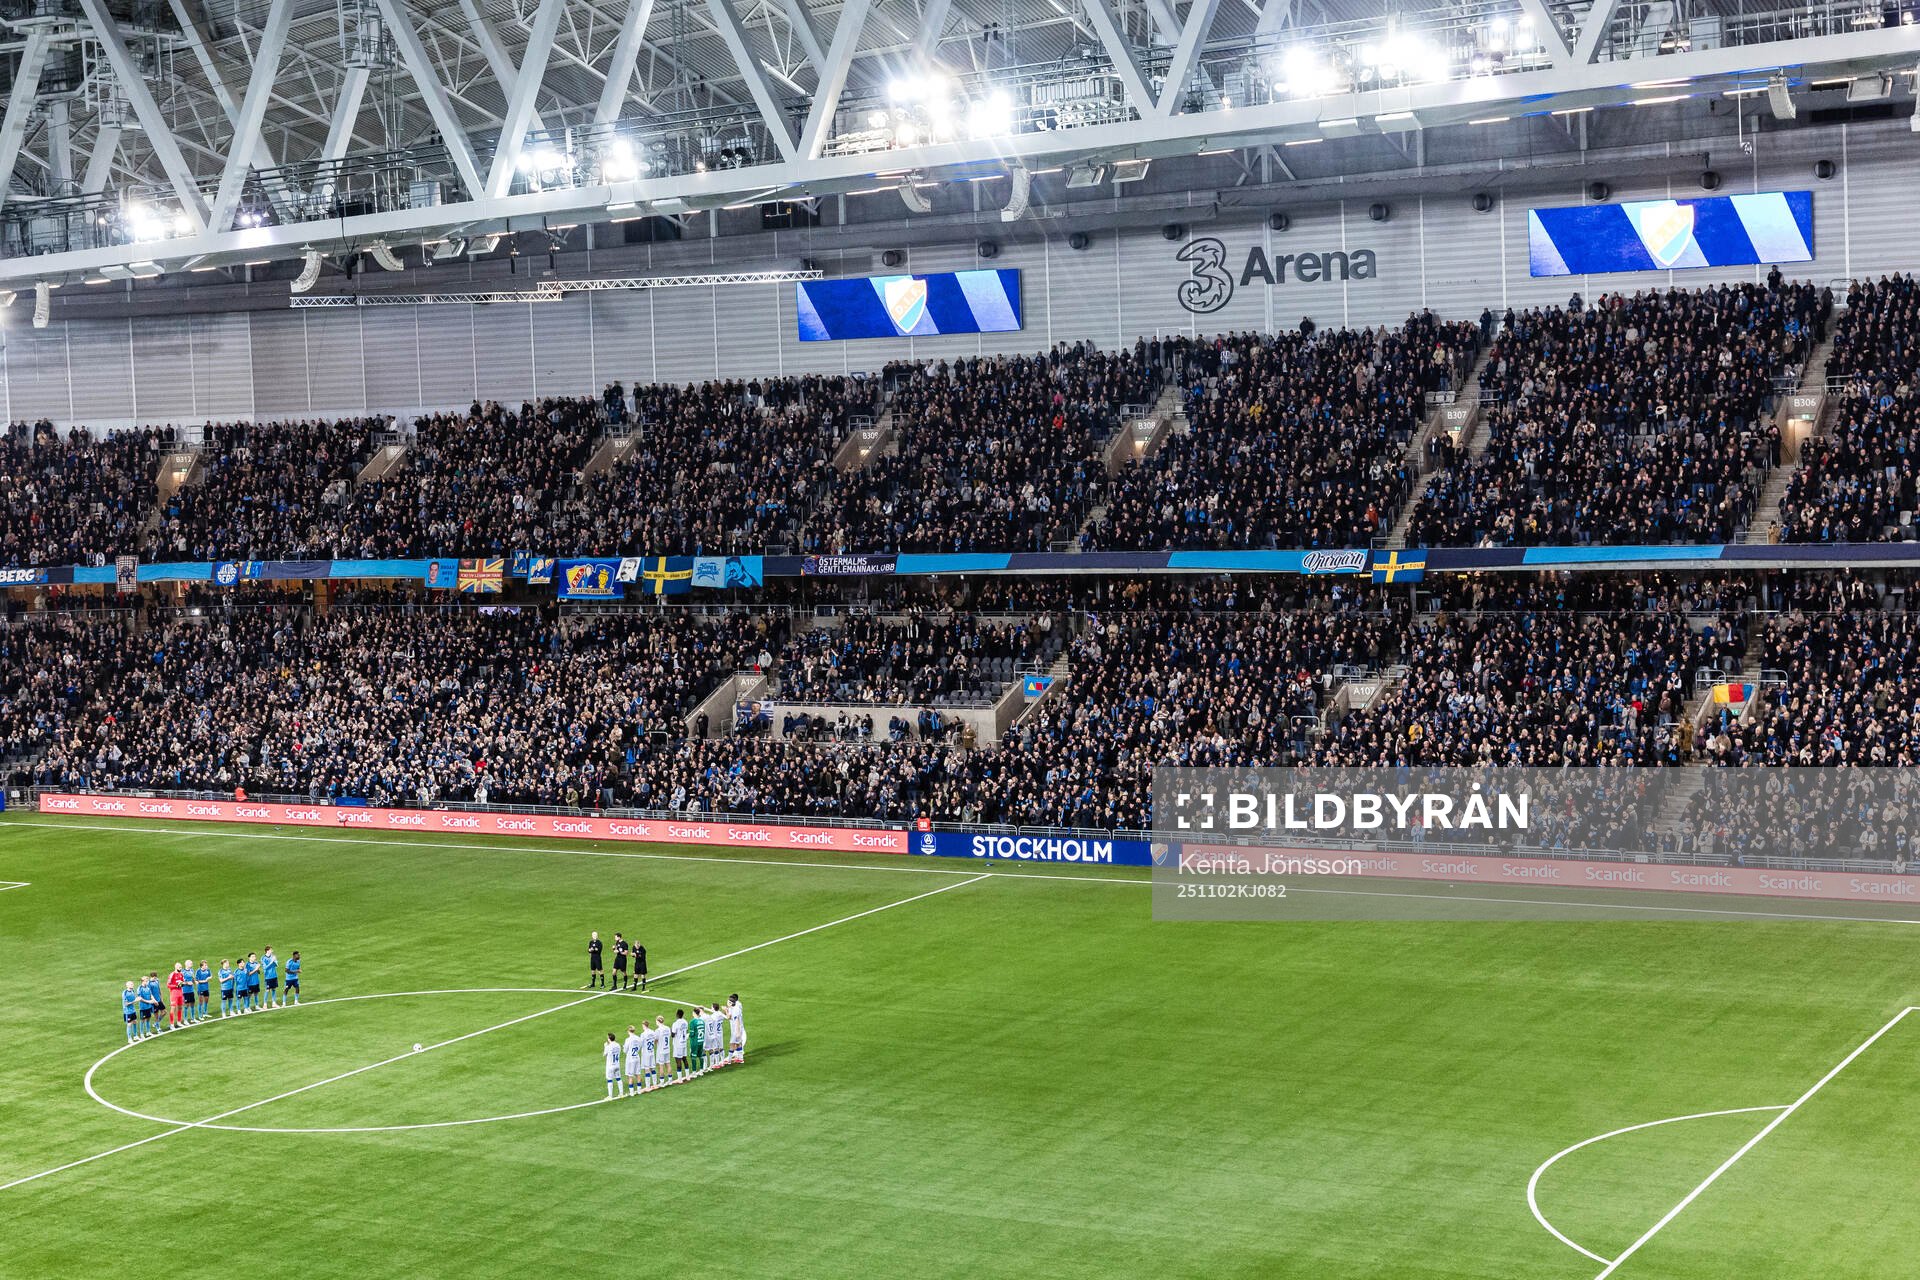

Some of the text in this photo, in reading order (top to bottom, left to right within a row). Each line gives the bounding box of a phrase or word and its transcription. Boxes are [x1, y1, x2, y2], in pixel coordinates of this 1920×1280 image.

[1240, 246, 1377, 286] Arena
[1794, 398, 1816, 407] B306
[1447, 411, 1466, 419] B307
[818, 563, 895, 574] GENTLEMANNAKLUBB
[0, 569, 35, 582] BERG
[1354, 686, 1375, 695] A107
[47, 798, 79, 809] Scandic
[92, 800, 125, 811] Scandic
[139, 802, 173, 814] Scandic
[187, 804, 222, 816] Scandic
[236, 806, 271, 818] Scandic
[285, 809, 321, 820] Scandic
[337, 811, 373, 823] Scandic
[388, 813, 426, 825] Scandic
[442, 815, 480, 828] Scandic
[497, 818, 536, 831] Scandic
[553, 820, 592, 833] Scandic
[609, 823, 651, 836] Scandic
[668, 826, 710, 839] Scandic
[728, 829, 771, 842] Scandic
[790, 831, 834, 845] Scandic
[853, 834, 898, 848] Scandic
[972, 836, 1112, 862] STOCKHOLM
[1422, 859, 1478, 875] Scandic
[1502, 863, 1560, 879] Scandic
[1585, 867, 1645, 883] Scandic
[1670, 870, 1732, 887] Scandic
[1759, 874, 1822, 891] Scandic
[1850, 878, 1915, 895] Scandic
